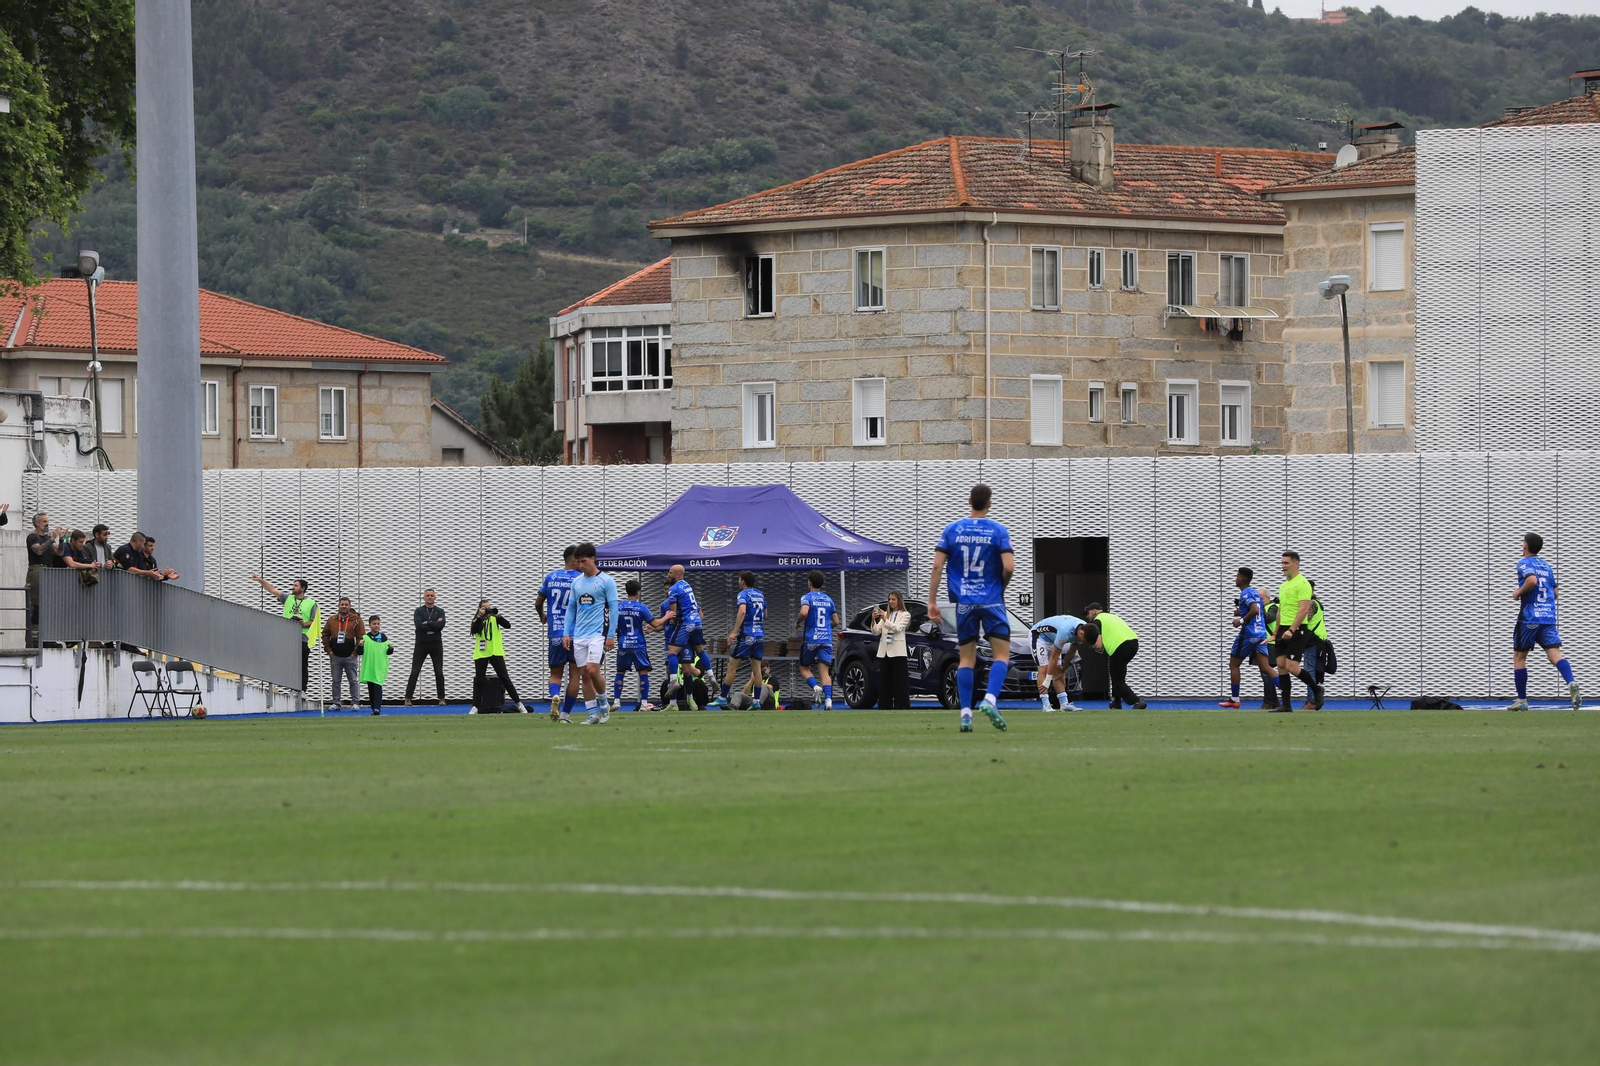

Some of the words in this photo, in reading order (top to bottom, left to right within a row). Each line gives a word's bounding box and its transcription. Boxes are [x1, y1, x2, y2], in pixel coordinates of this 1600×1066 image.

[955, 536, 971, 544] ADRI
[598, 557, 648, 567] FEDERACIÓN
[689, 559, 721, 567] GALEGA
[778, 557, 789, 565] DE
[790, 556, 822, 565] FÚTBOL
[960, 545, 985, 578] 14
[1536, 577, 1547, 602] 5
[688, 592, 698, 610] 9
[624, 616, 635, 636] 3
[816, 607, 826, 628] 6
[1040, 647, 1045, 656] 2
